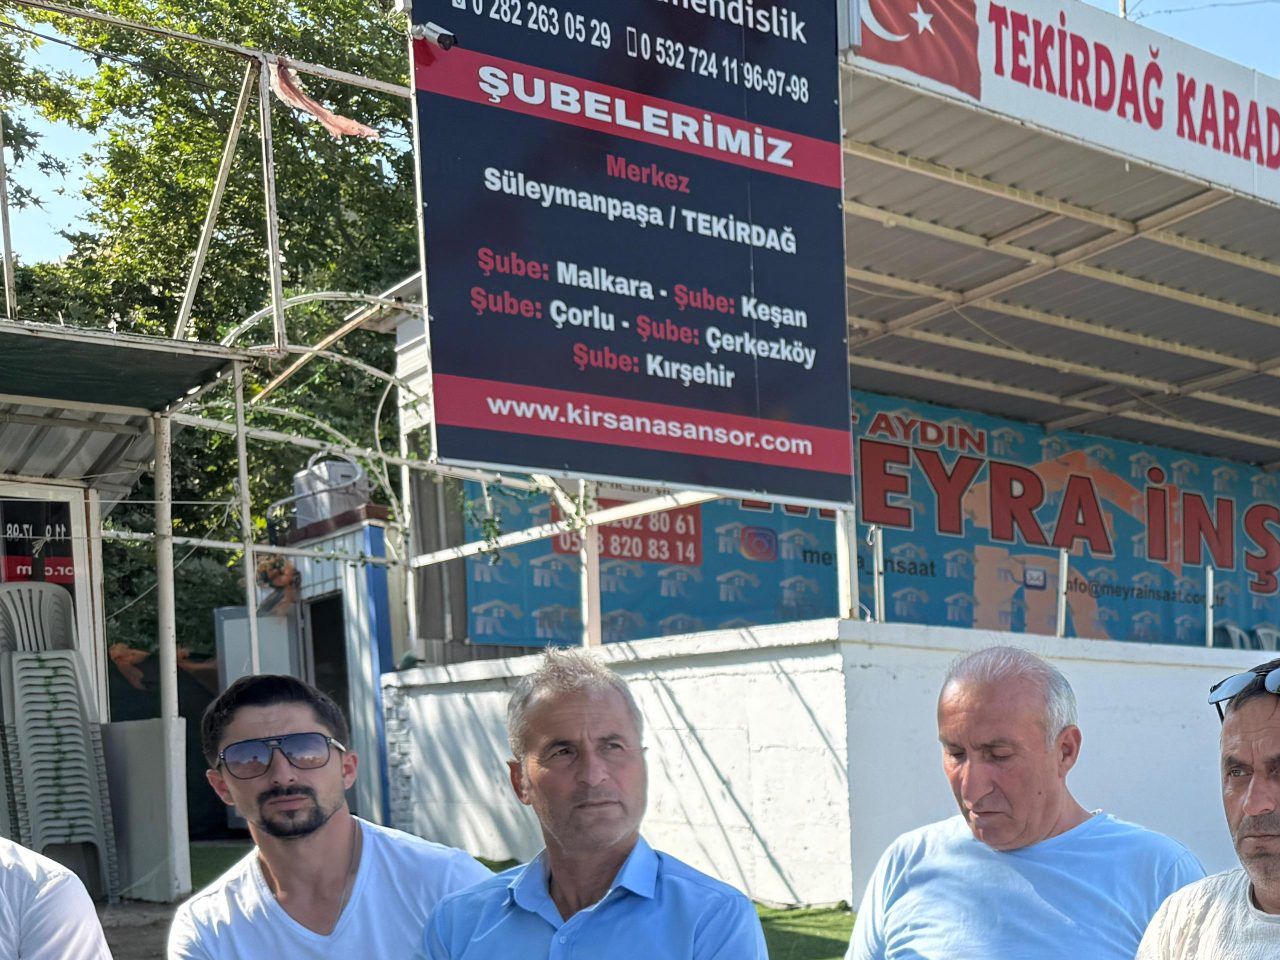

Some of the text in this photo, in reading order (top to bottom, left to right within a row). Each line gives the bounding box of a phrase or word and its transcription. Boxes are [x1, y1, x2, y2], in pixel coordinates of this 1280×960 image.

[489, 0, 523, 26] 282
[527, 2, 560, 35] 263
[564, 12, 586, 42] 05
[591, 19, 611, 49] 29
[640, 33, 650, 60] 0
[656, 40, 685, 70] 532
[689, 46, 718, 79] 724
[722, 57, 738, 85] 11
[744, 61, 809, 103] 96-97-98
[660, 0, 807, 44] endislik
[988, 5, 1164, 131] TEKİRDAĞ
[478, 65, 794, 168] ŞUBELERİMİZ
[607, 154, 691, 194] Merkez
[484, 167, 797, 254] Süleymanpaşa / TEKİRDAĞ
[477, 247, 550, 281] Şube:
[556, 261, 654, 300] Malkara
[674, 284, 734, 314] Şube:
[742, 296, 808, 329] Keşan
[470, 287, 542, 319] Şube:
[550, 299, 615, 332] Çorlu
[637, 315, 699, 345] Şube:
[706, 326, 817, 370] Çerkezköy
[573, 343, 735, 388] Şube: Kırşehir
[486, 396, 813, 456] www.kirsanasansor.com
[867, 411, 986, 456] AYDIN
[675, 514, 696, 536] 61
[740, 437, 1113, 560] EYRA
[610, 535, 643, 558] 820
[648, 539, 670, 560] 83
[676, 542, 696, 563] 14
